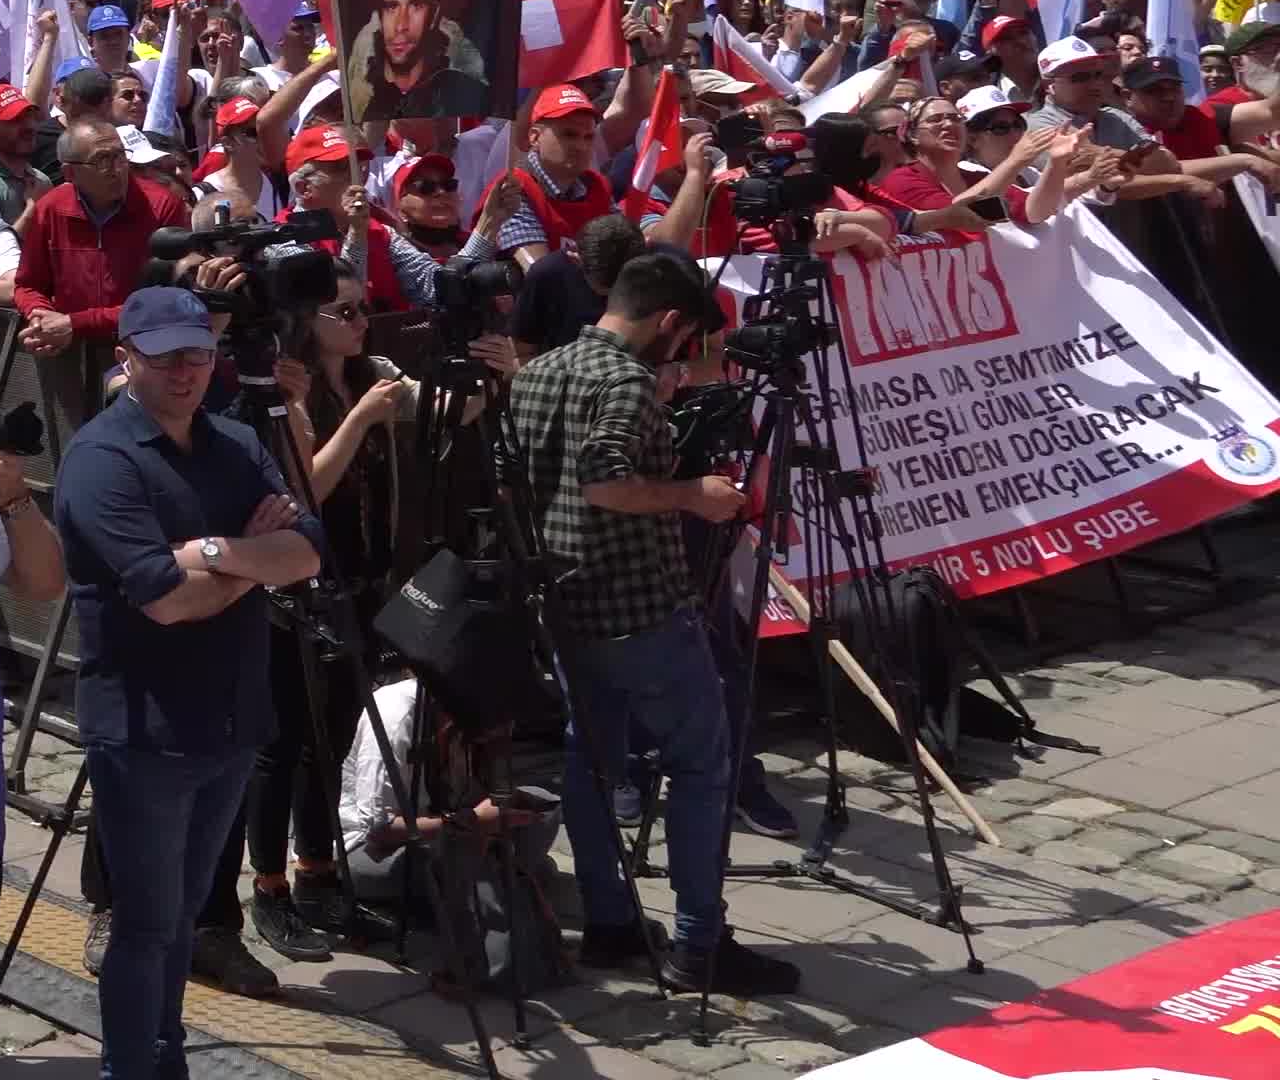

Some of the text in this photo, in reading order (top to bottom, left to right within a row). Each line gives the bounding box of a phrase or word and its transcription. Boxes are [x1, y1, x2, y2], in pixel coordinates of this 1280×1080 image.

[938, 364, 975, 398] DA
[973, 323, 1139, 390] SEMTİMİZE
[860, 381, 1086, 456] GÜNEŞLİ GÜNLER
[887, 437, 1009, 491] YENİDEN
[1007, 370, 1222, 464] DOĞURACAK
[970, 549, 992, 578] 5
[991, 527, 1074, 573] NO'LU
[1073, 500, 1161, 551] ŞUBE
